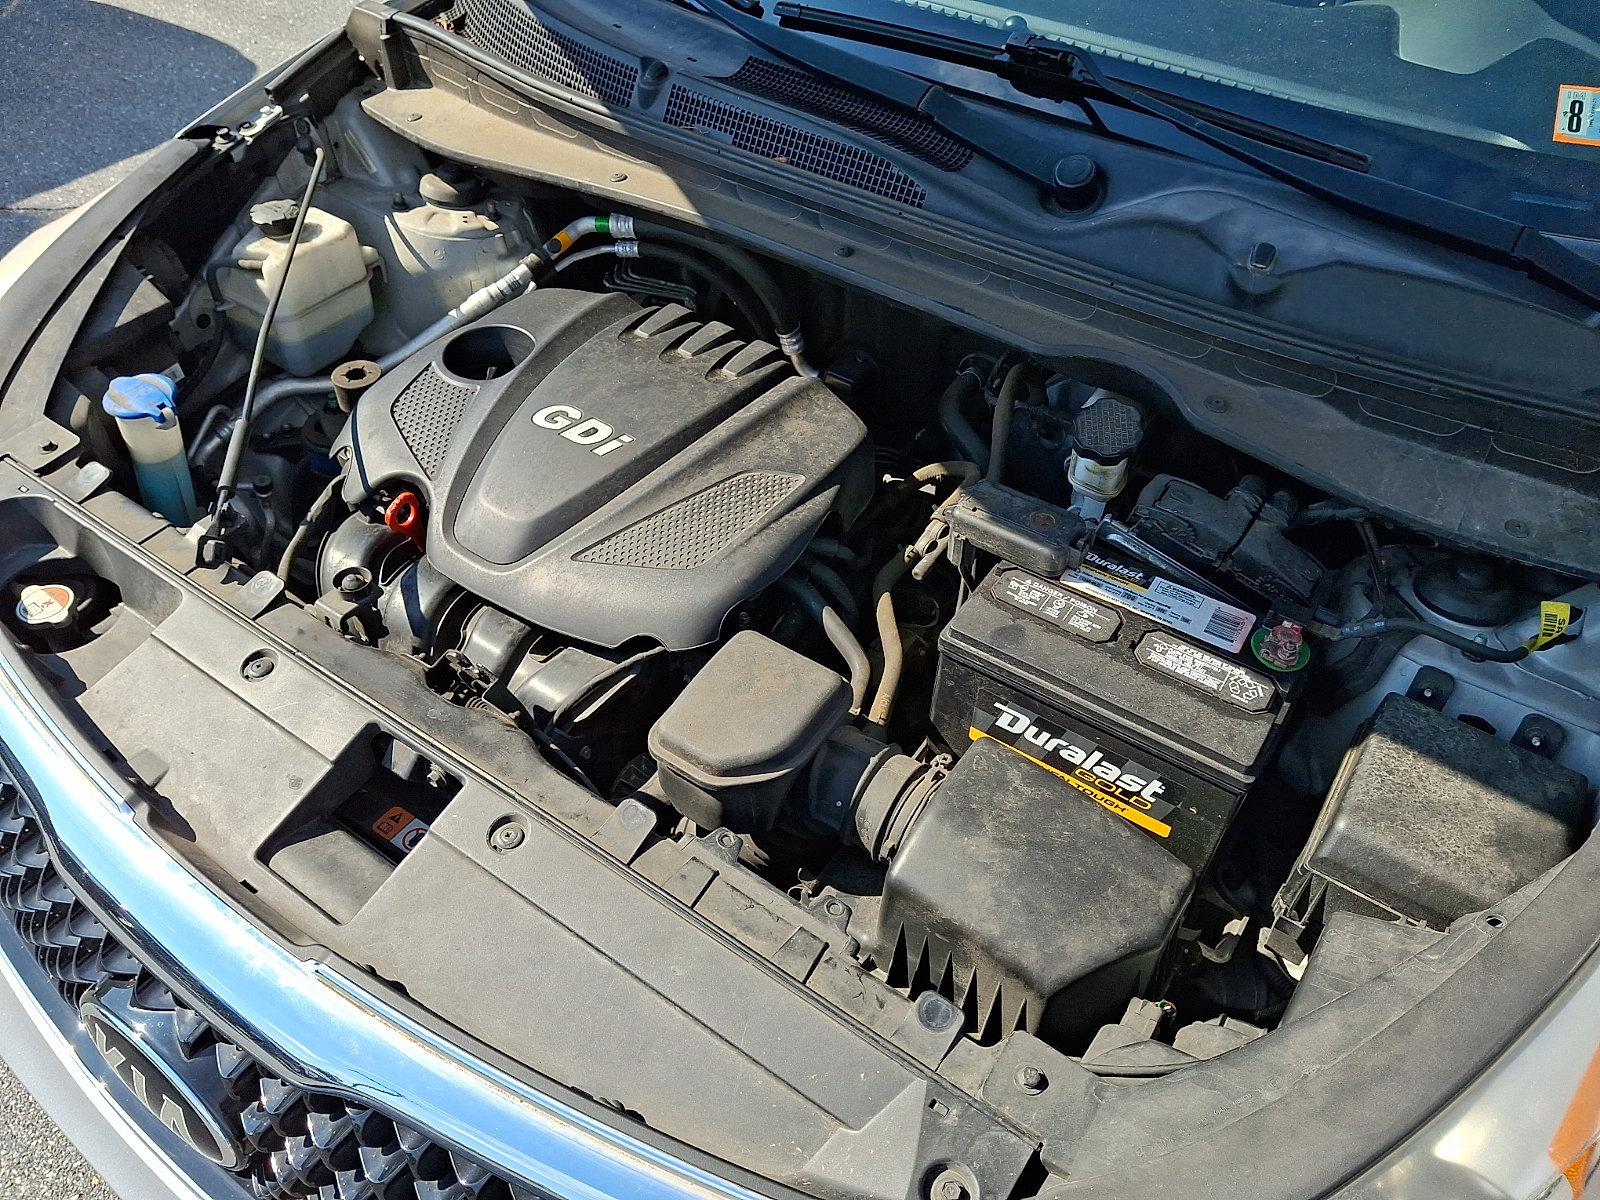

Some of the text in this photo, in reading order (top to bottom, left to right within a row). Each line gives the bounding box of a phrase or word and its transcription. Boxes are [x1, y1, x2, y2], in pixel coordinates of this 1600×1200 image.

[1567, 100, 1584, 133] 8
[531, 404, 636, 456] GDi
[1085, 551, 1144, 580] Duralast
[1032, 581, 1064, 599] DANGER
[1070, 597, 1098, 613] POISON
[1123, 592, 1136, 601] 700
[993, 702, 1165, 803] Duralast
[1074, 768, 1152, 810] GOLD
